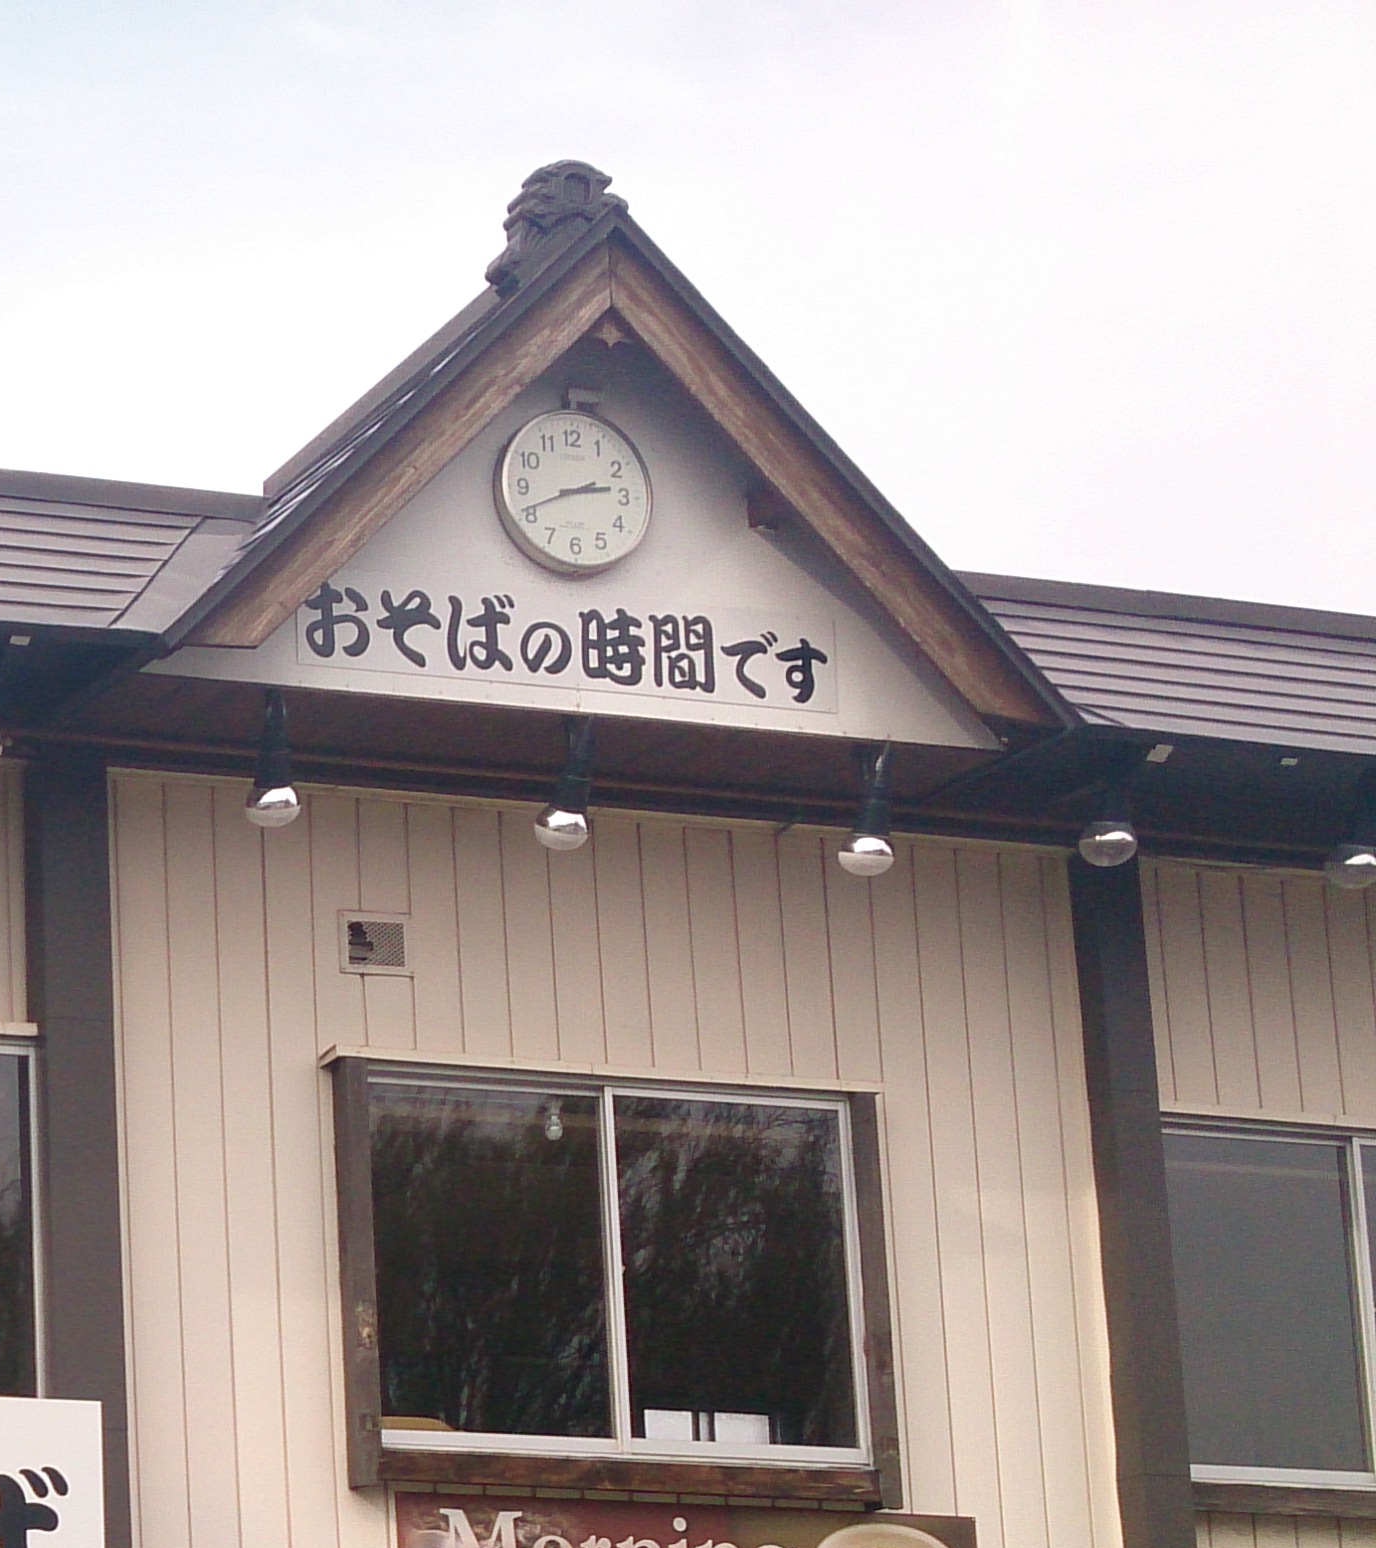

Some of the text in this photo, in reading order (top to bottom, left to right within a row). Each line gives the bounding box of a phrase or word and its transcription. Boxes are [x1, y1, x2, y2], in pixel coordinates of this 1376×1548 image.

[541, 434, 554, 452] 11
[563, 430, 581, 448] 12
[594, 440, 601, 457] 1
[520, 451, 539, 469] 10
[610, 461, 623, 478] 2
[517, 477, 529, 495] 9
[618, 488, 630, 506] 3
[525, 506, 537, 523] 8
[612, 515, 625, 533] 4
[544, 527, 556, 544] 7
[594, 532, 607, 550] 5
[569, 537, 582, 555] 6
[304, 582, 828, 704] おそばの時間です
